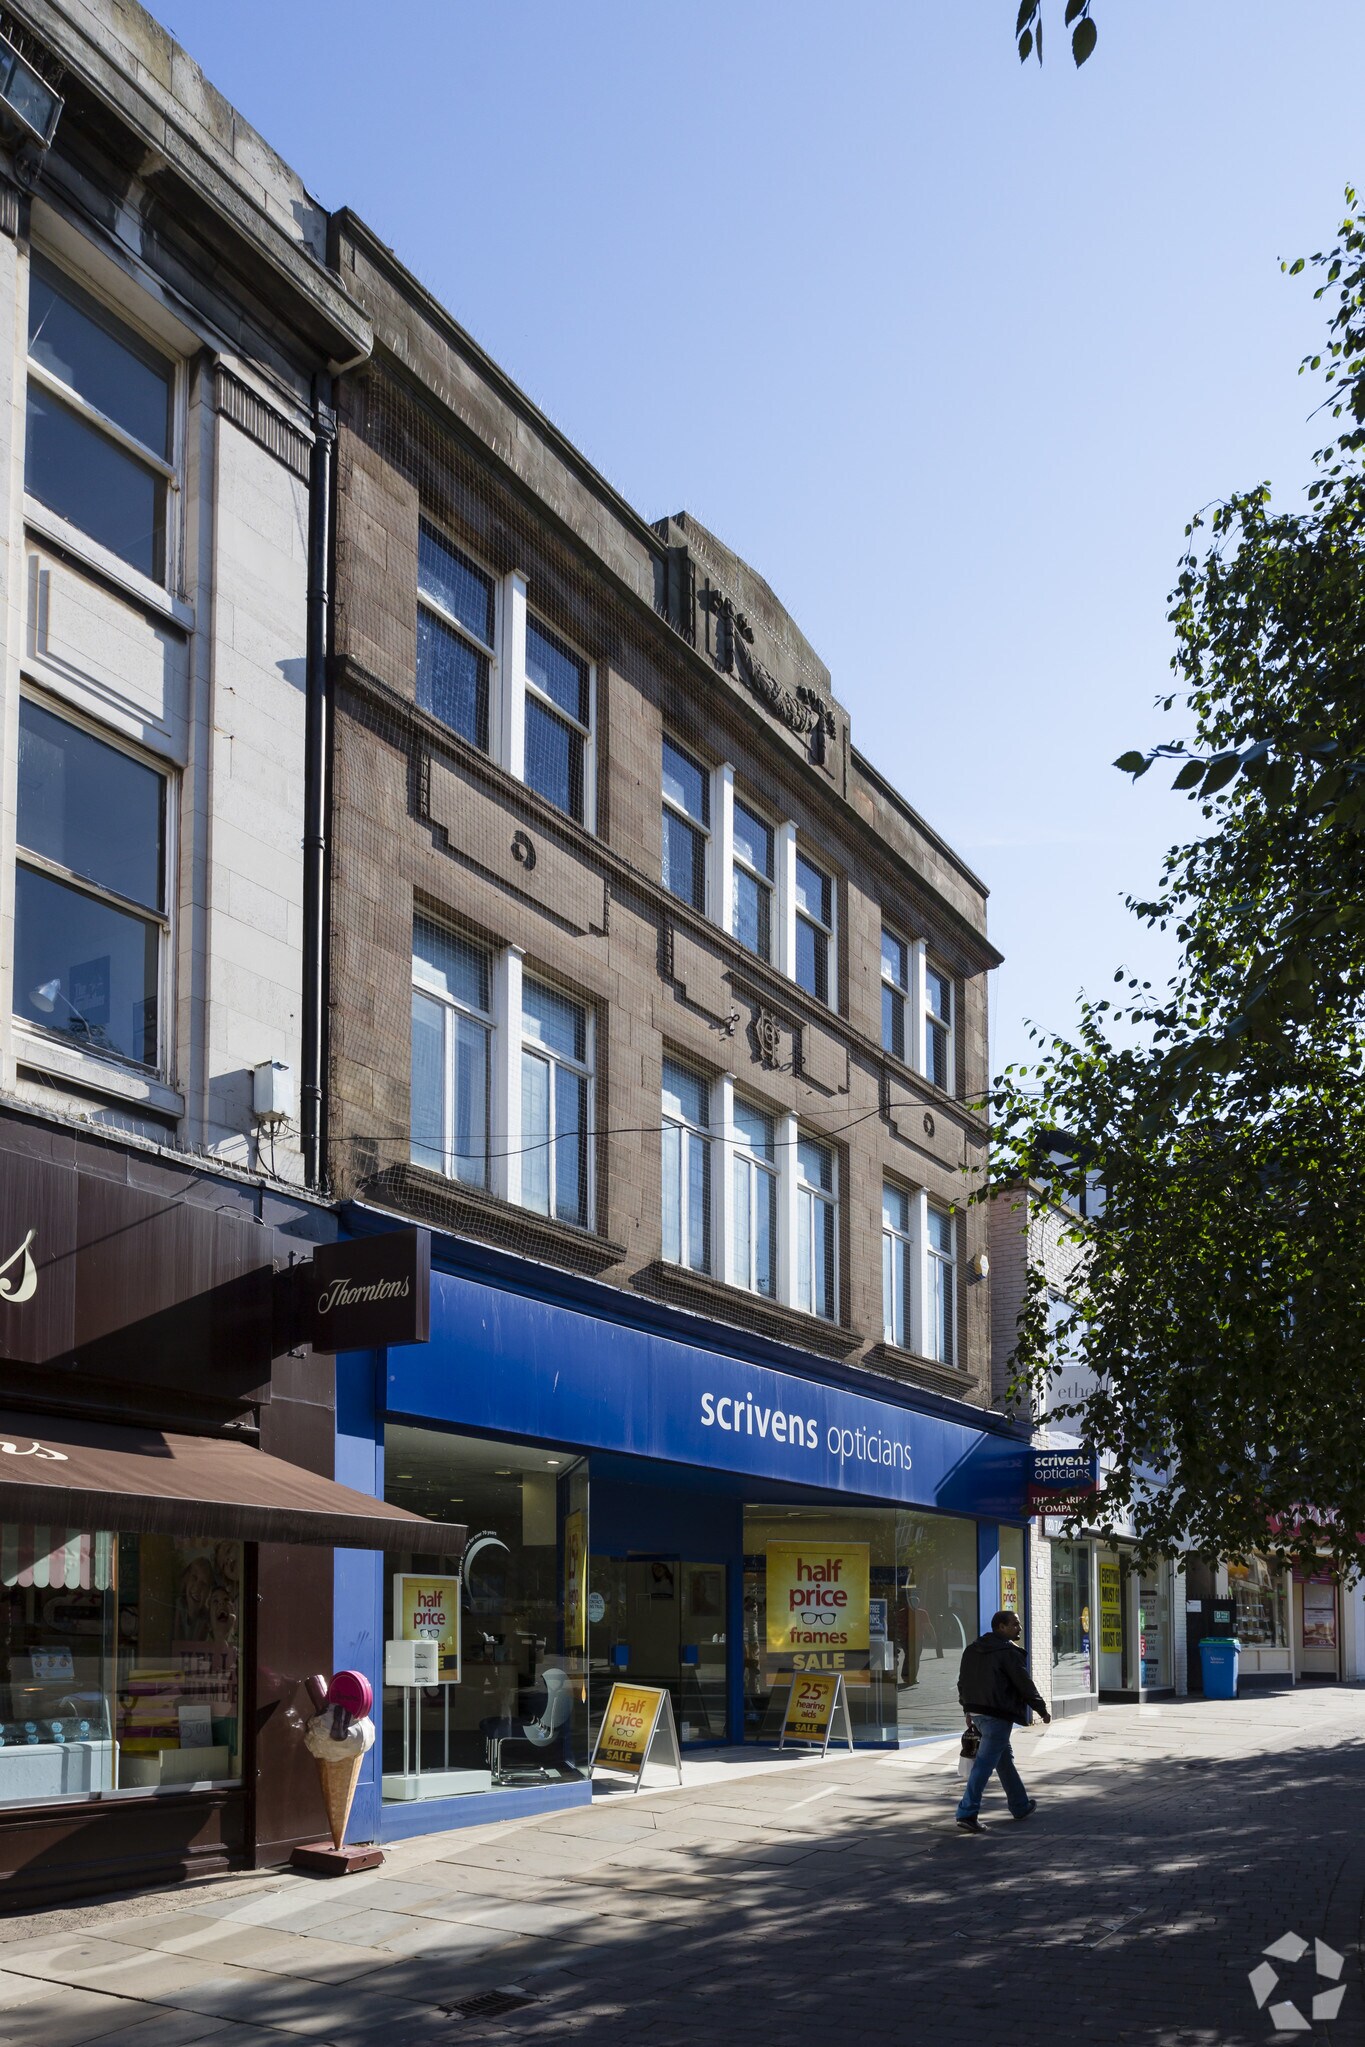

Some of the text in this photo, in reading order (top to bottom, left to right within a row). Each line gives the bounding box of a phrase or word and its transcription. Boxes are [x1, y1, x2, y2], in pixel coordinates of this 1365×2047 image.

[318, 1275, 410, 1314] Thorntons
[700, 1391, 912, 1471] scrivens opticians
[1034, 1454, 1090, 1467] scrivens
[1034, 1467, 1090, 1482] opticians
[797, 1558, 843, 1582] half
[1005, 1577, 1015, 1590] half
[418, 1590, 443, 1608] half
[789, 1584, 848, 1612] price
[1003, 1591, 1016, 1605] price
[413, 1609, 446, 1629] price
[790, 1626, 848, 1645] frames
[792, 1652, 845, 1670] SALE
[621, 1697, 647, 1714] half
[796, 1699, 826, 1712] hearing
[612, 1713, 644, 1728] price
[801, 1710, 817, 1719] aids
[795, 1723, 818, 1732] SALE
[607, 1735, 637, 1749] frames
[606, 1751, 632, 1762] SALE
